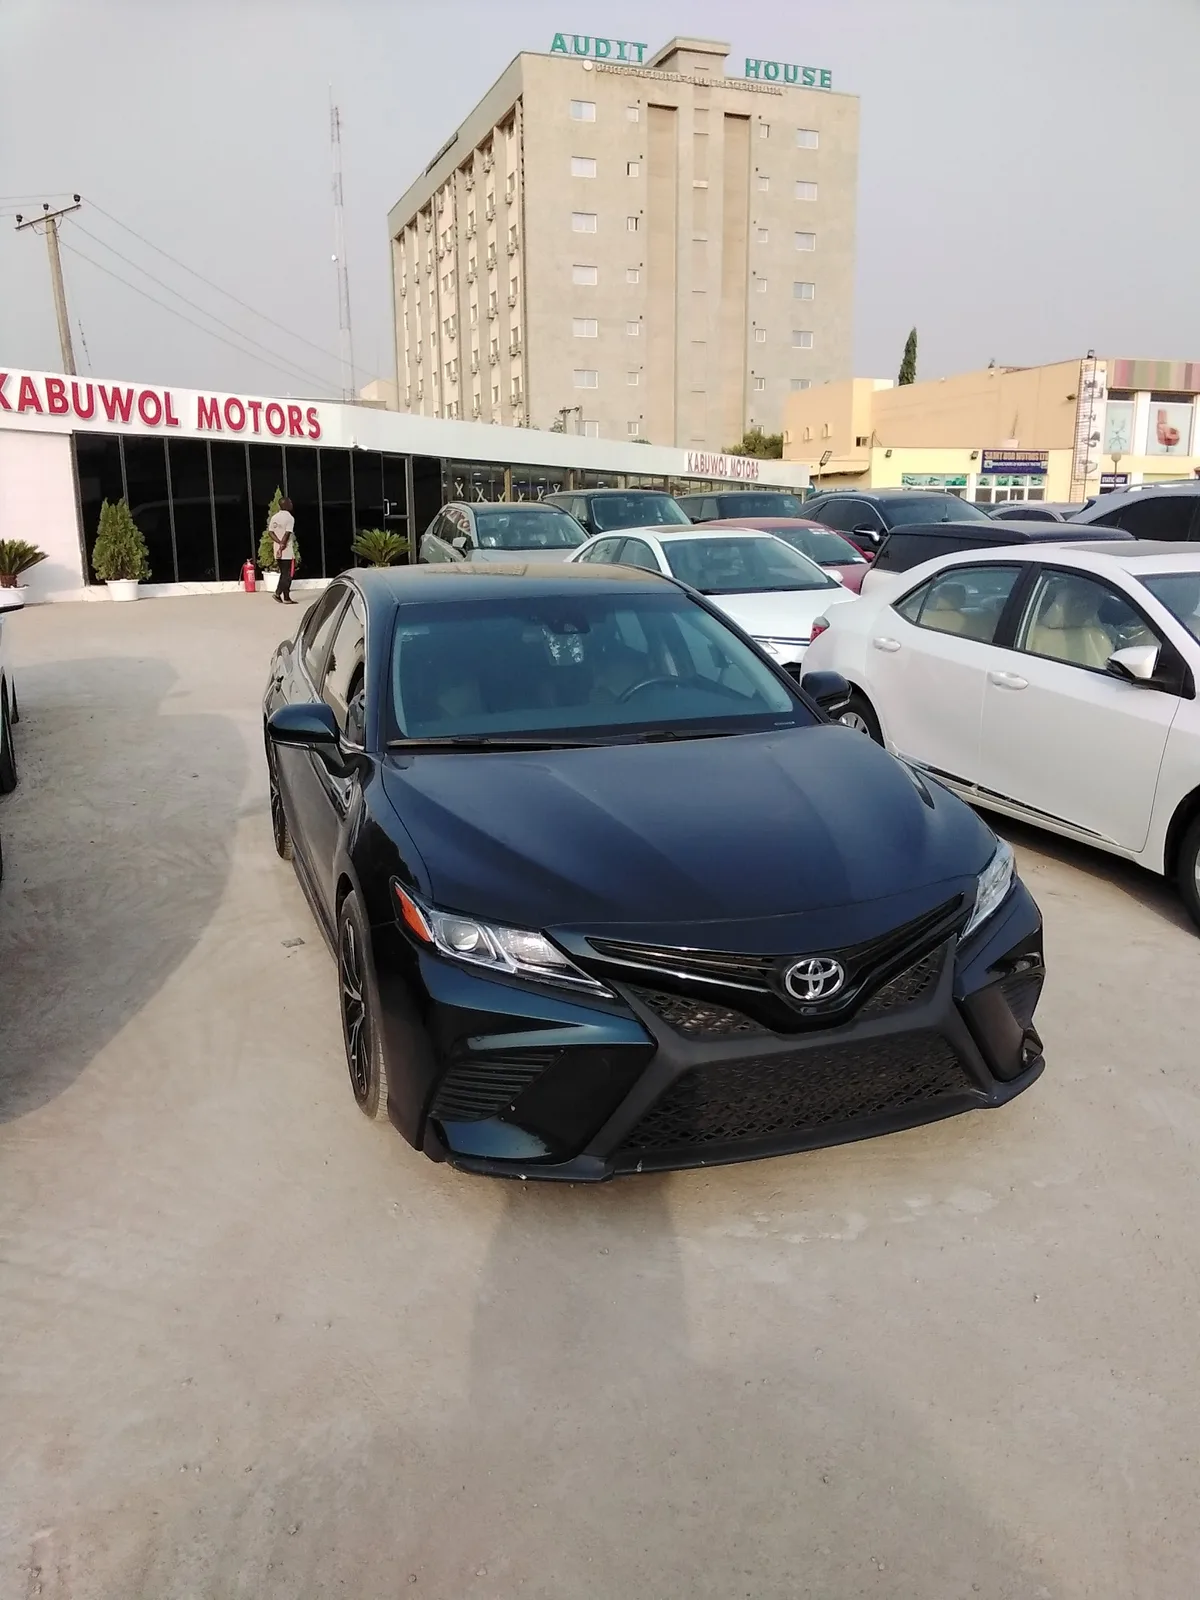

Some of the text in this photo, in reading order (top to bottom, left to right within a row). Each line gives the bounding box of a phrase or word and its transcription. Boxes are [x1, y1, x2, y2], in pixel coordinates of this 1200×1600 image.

[551, 32, 648, 63] AUDIT
[745, 57, 832, 88] HOUSE
[196, 394, 323, 440] MOTORS
[688, 452, 758, 479] KABUWOL MOTORS
